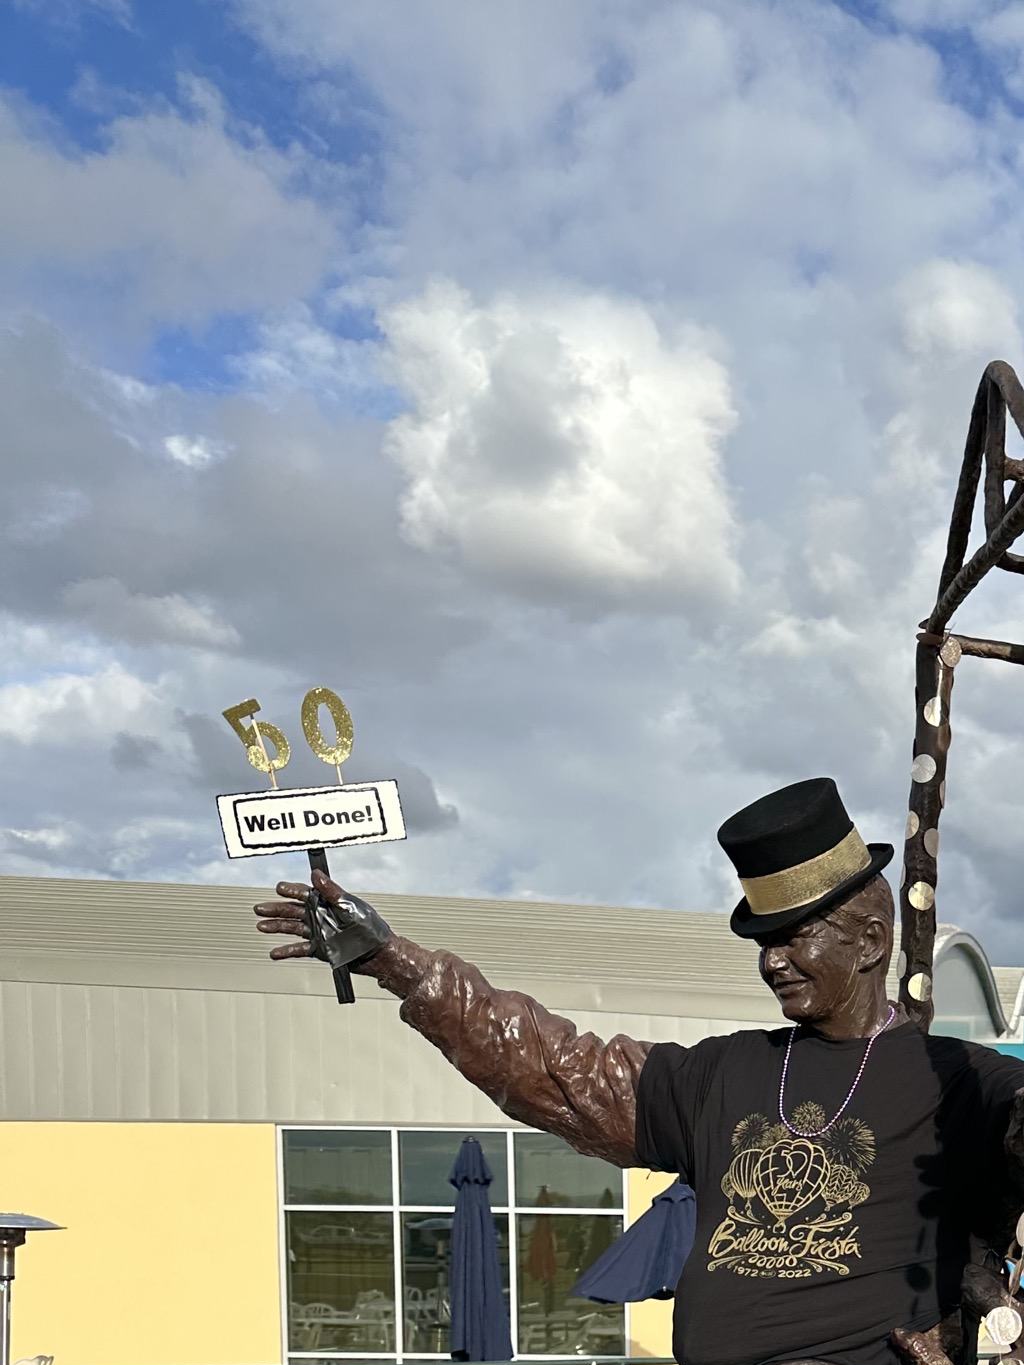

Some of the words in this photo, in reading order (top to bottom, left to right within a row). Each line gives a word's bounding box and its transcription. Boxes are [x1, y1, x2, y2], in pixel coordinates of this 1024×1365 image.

[222, 686, 354, 773] 50
[244, 811, 296, 833] Well
[303, 804, 373, 828] Done!
[707, 1217, 790, 1258] Balloon
[788, 1224, 862, 1262] Fiesta
[733, 1265, 759, 1277] 1972
[777, 1269, 812, 1279] 2022
